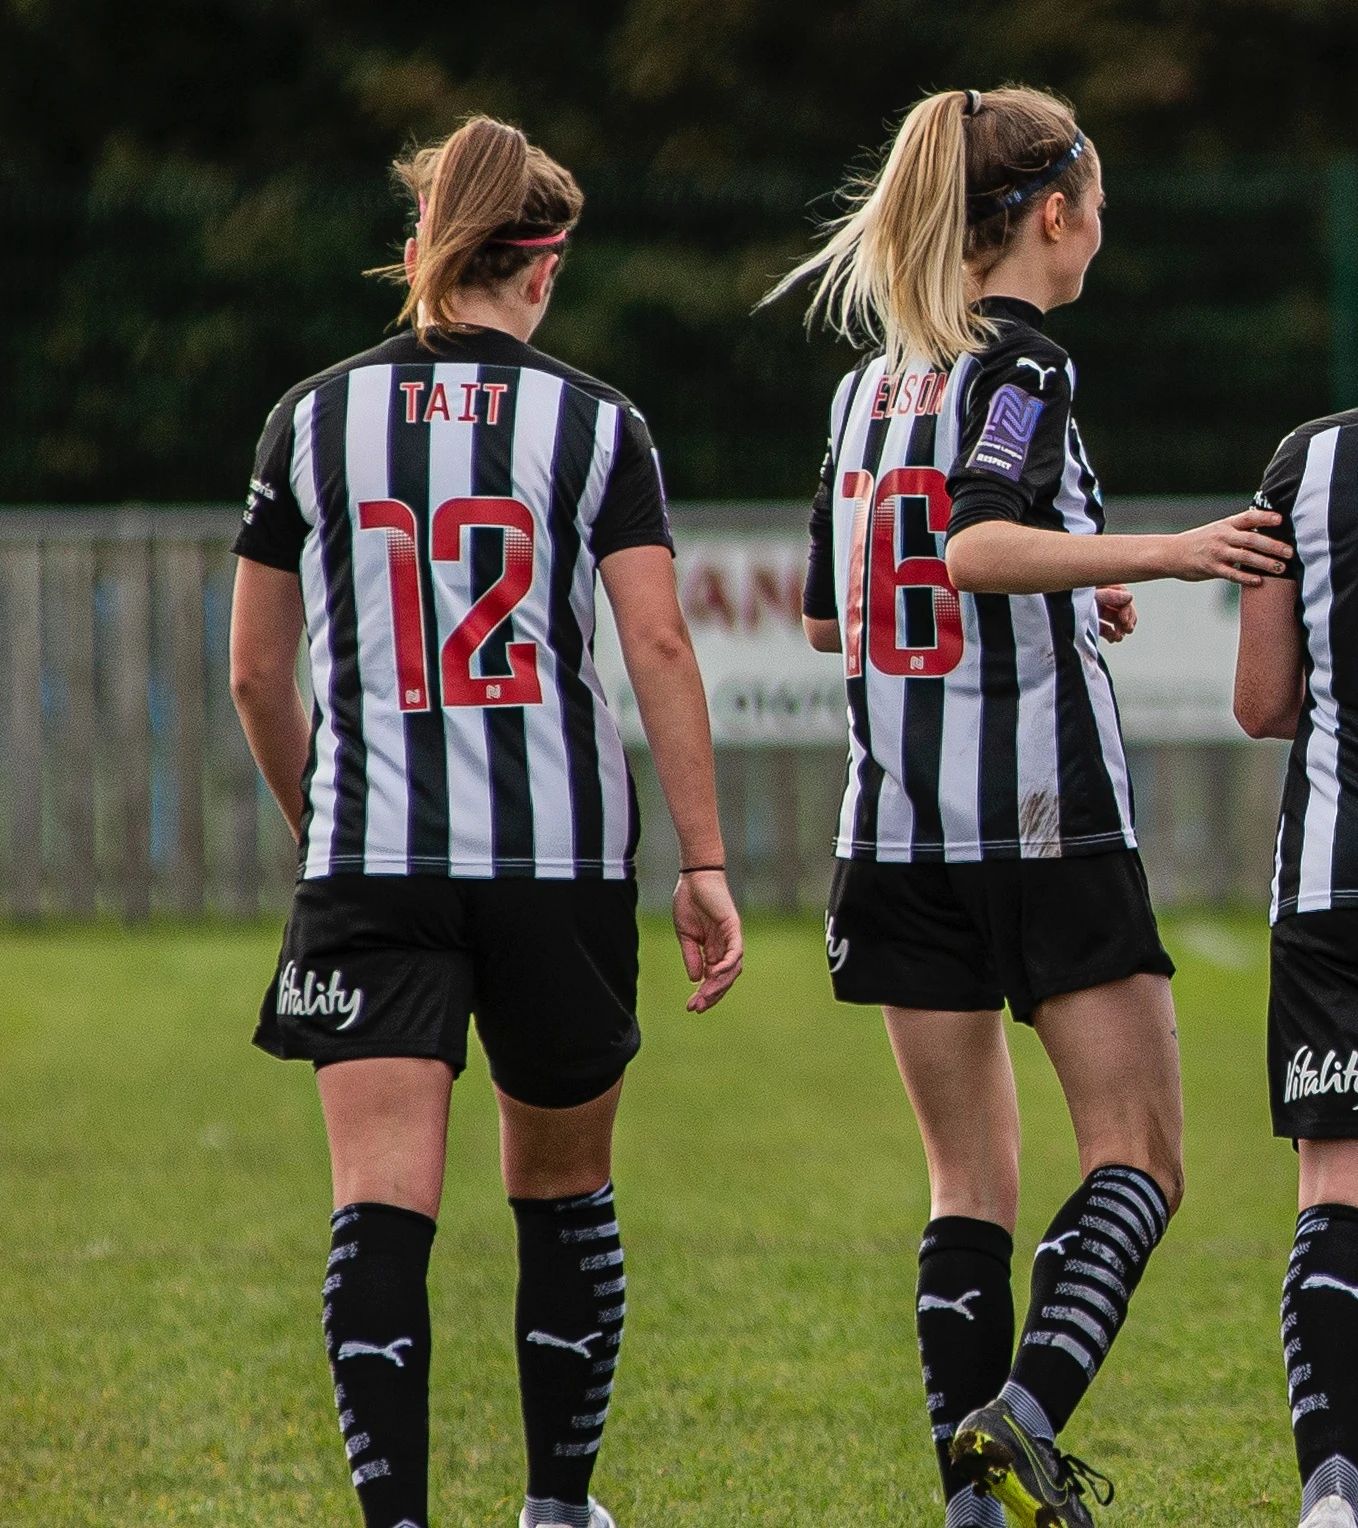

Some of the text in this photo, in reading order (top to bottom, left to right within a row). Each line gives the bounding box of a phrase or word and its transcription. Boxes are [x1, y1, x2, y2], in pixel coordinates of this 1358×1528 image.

[400, 381, 507, 424] TAIT
[358, 496, 544, 712] 12
[841, 467, 964, 679] 16
[276, 960, 362, 1030] Vitality
